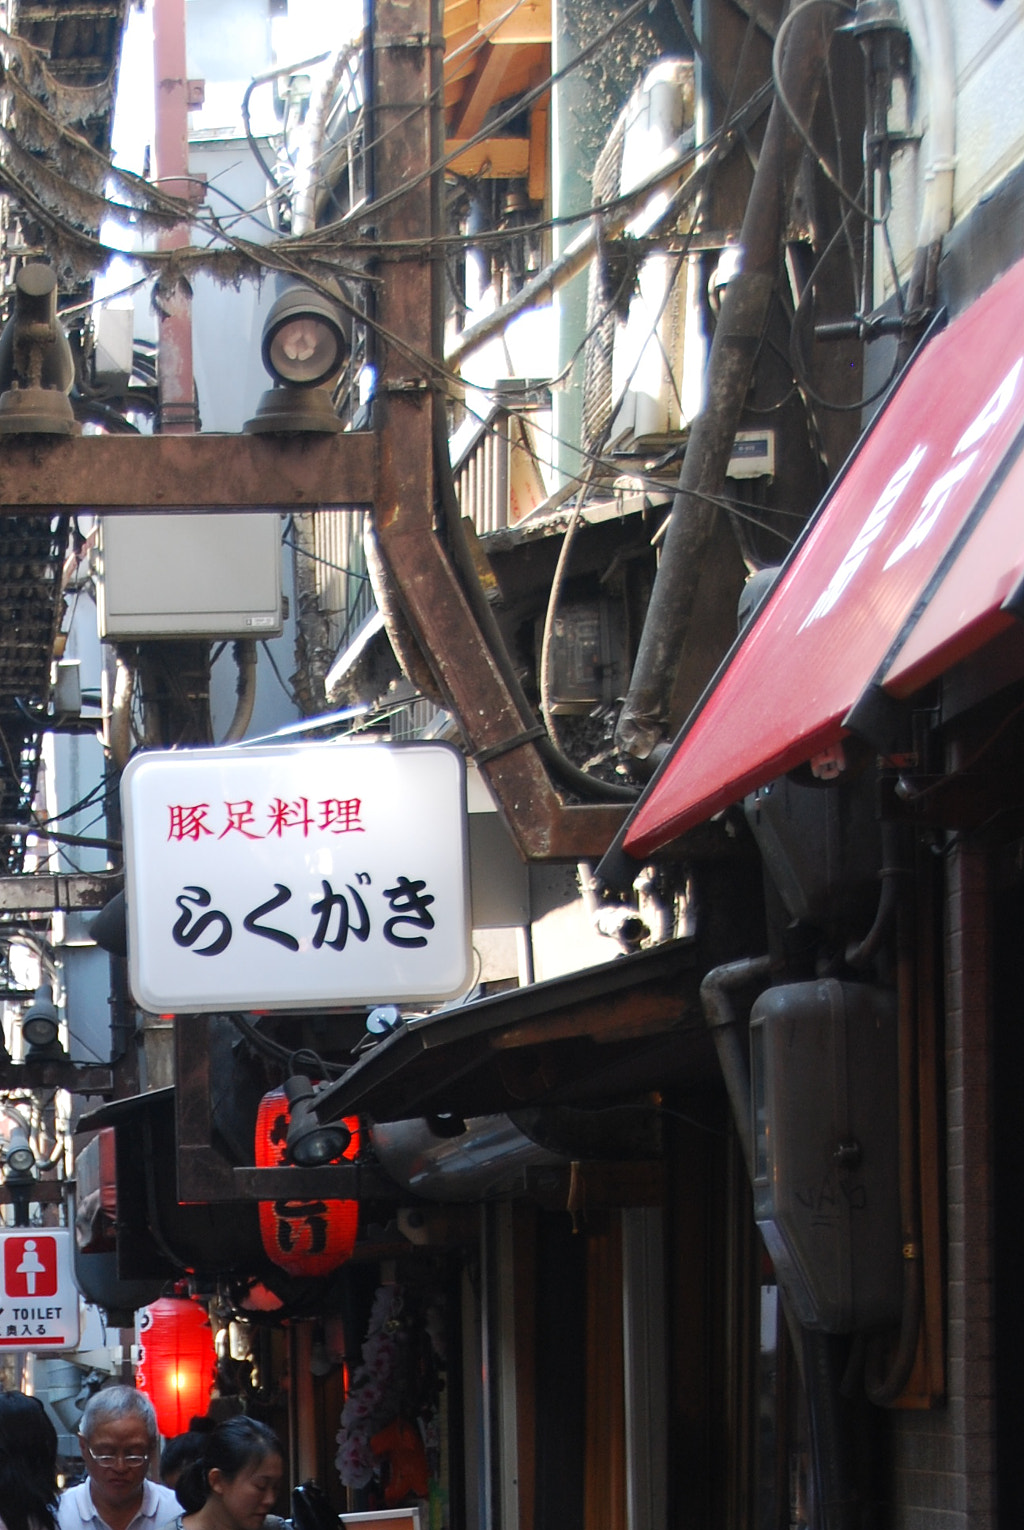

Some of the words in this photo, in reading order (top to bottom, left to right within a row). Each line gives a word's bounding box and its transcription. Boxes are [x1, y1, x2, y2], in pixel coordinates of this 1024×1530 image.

[166, 796, 366, 844] 豚足料理
[170, 870, 438, 958] らくがき
[12, 1307, 62, 1321] TOILET
